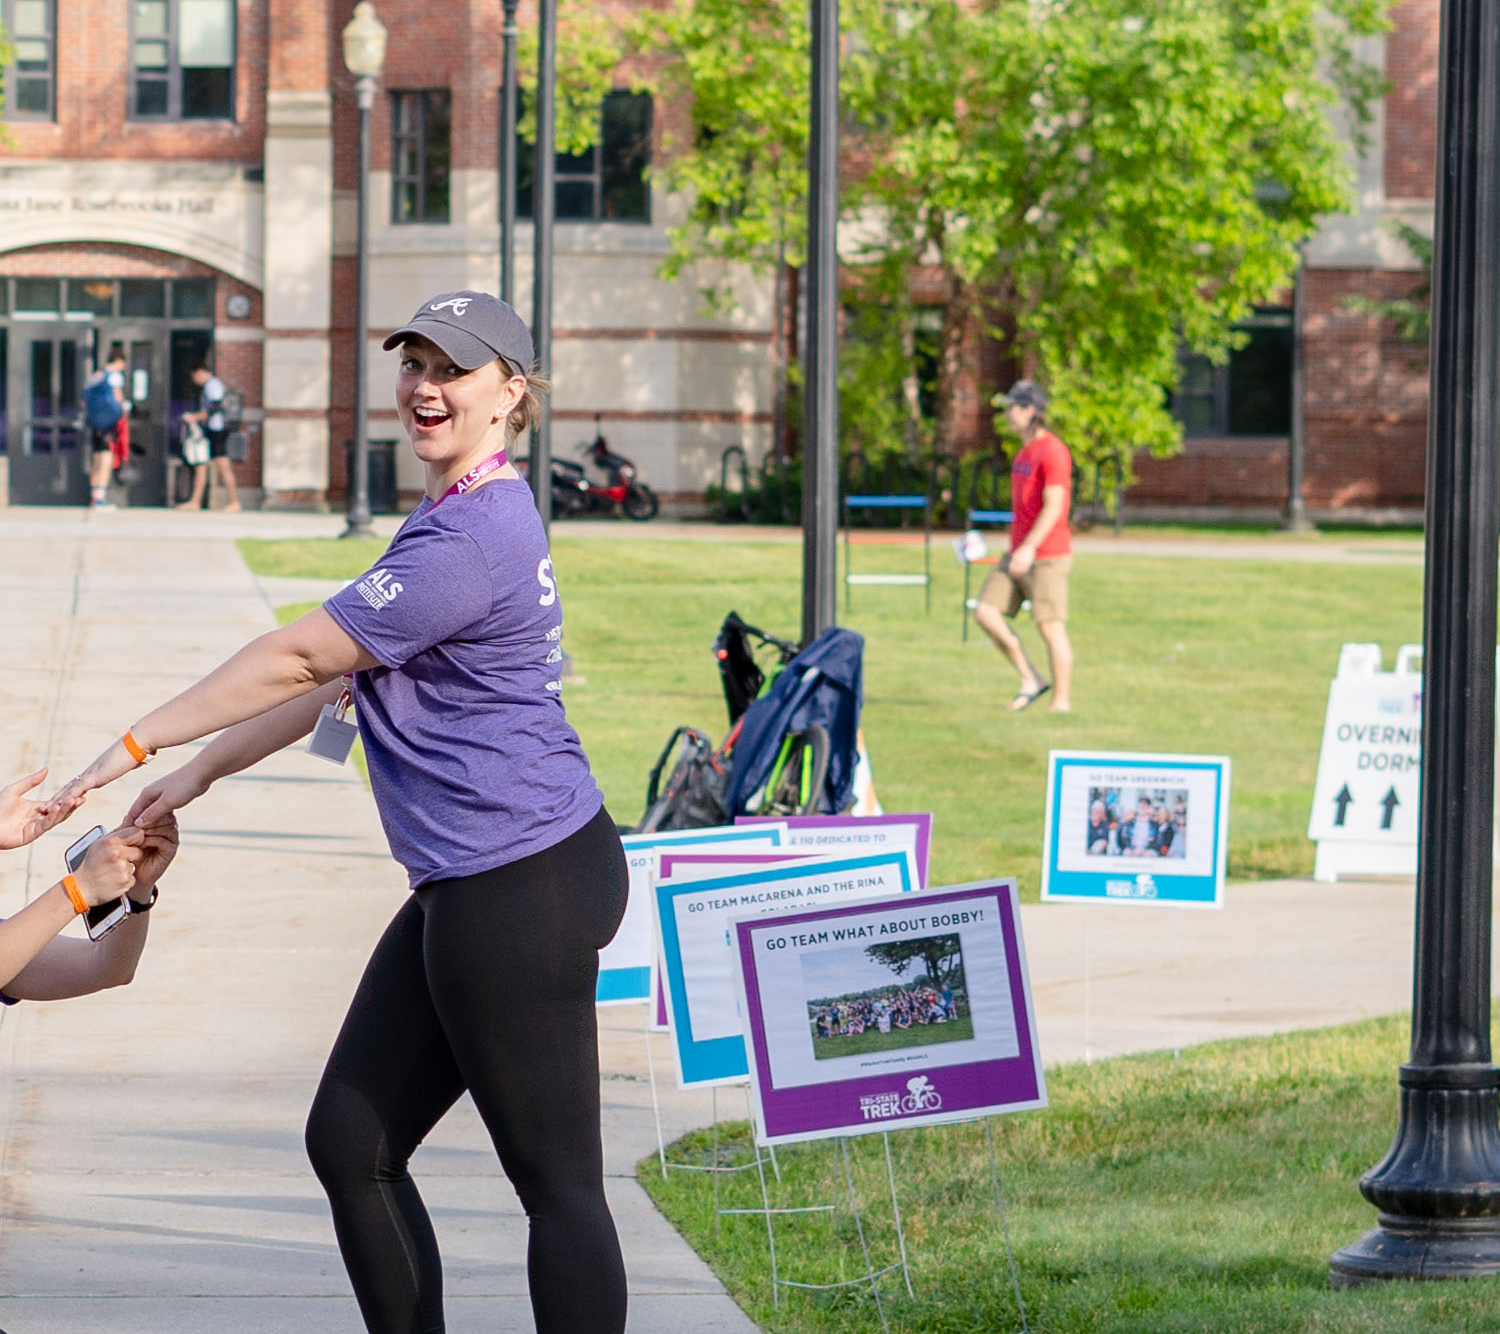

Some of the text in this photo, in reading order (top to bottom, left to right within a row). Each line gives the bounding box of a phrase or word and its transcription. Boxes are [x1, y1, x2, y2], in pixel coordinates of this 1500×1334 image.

[456, 469, 480, 494] ALS
[368, 568, 403, 601] ALS
[1337, 723, 1419, 744] OVERNI
[1357, 752, 1420, 772] DORM
[816, 835, 871, 844] DEDICATED
[874, 834, 886, 842] TO
[630, 857, 647, 867] GO
[688, 876, 885, 913] GO TEAM MACARENA AND THE RINA
[766, 910, 985, 951] GO TEAM WHAT ABOUT BOBBY!
[859, 1093, 900, 1106] TRI-STATE
[860, 1102, 902, 1120] TREK
